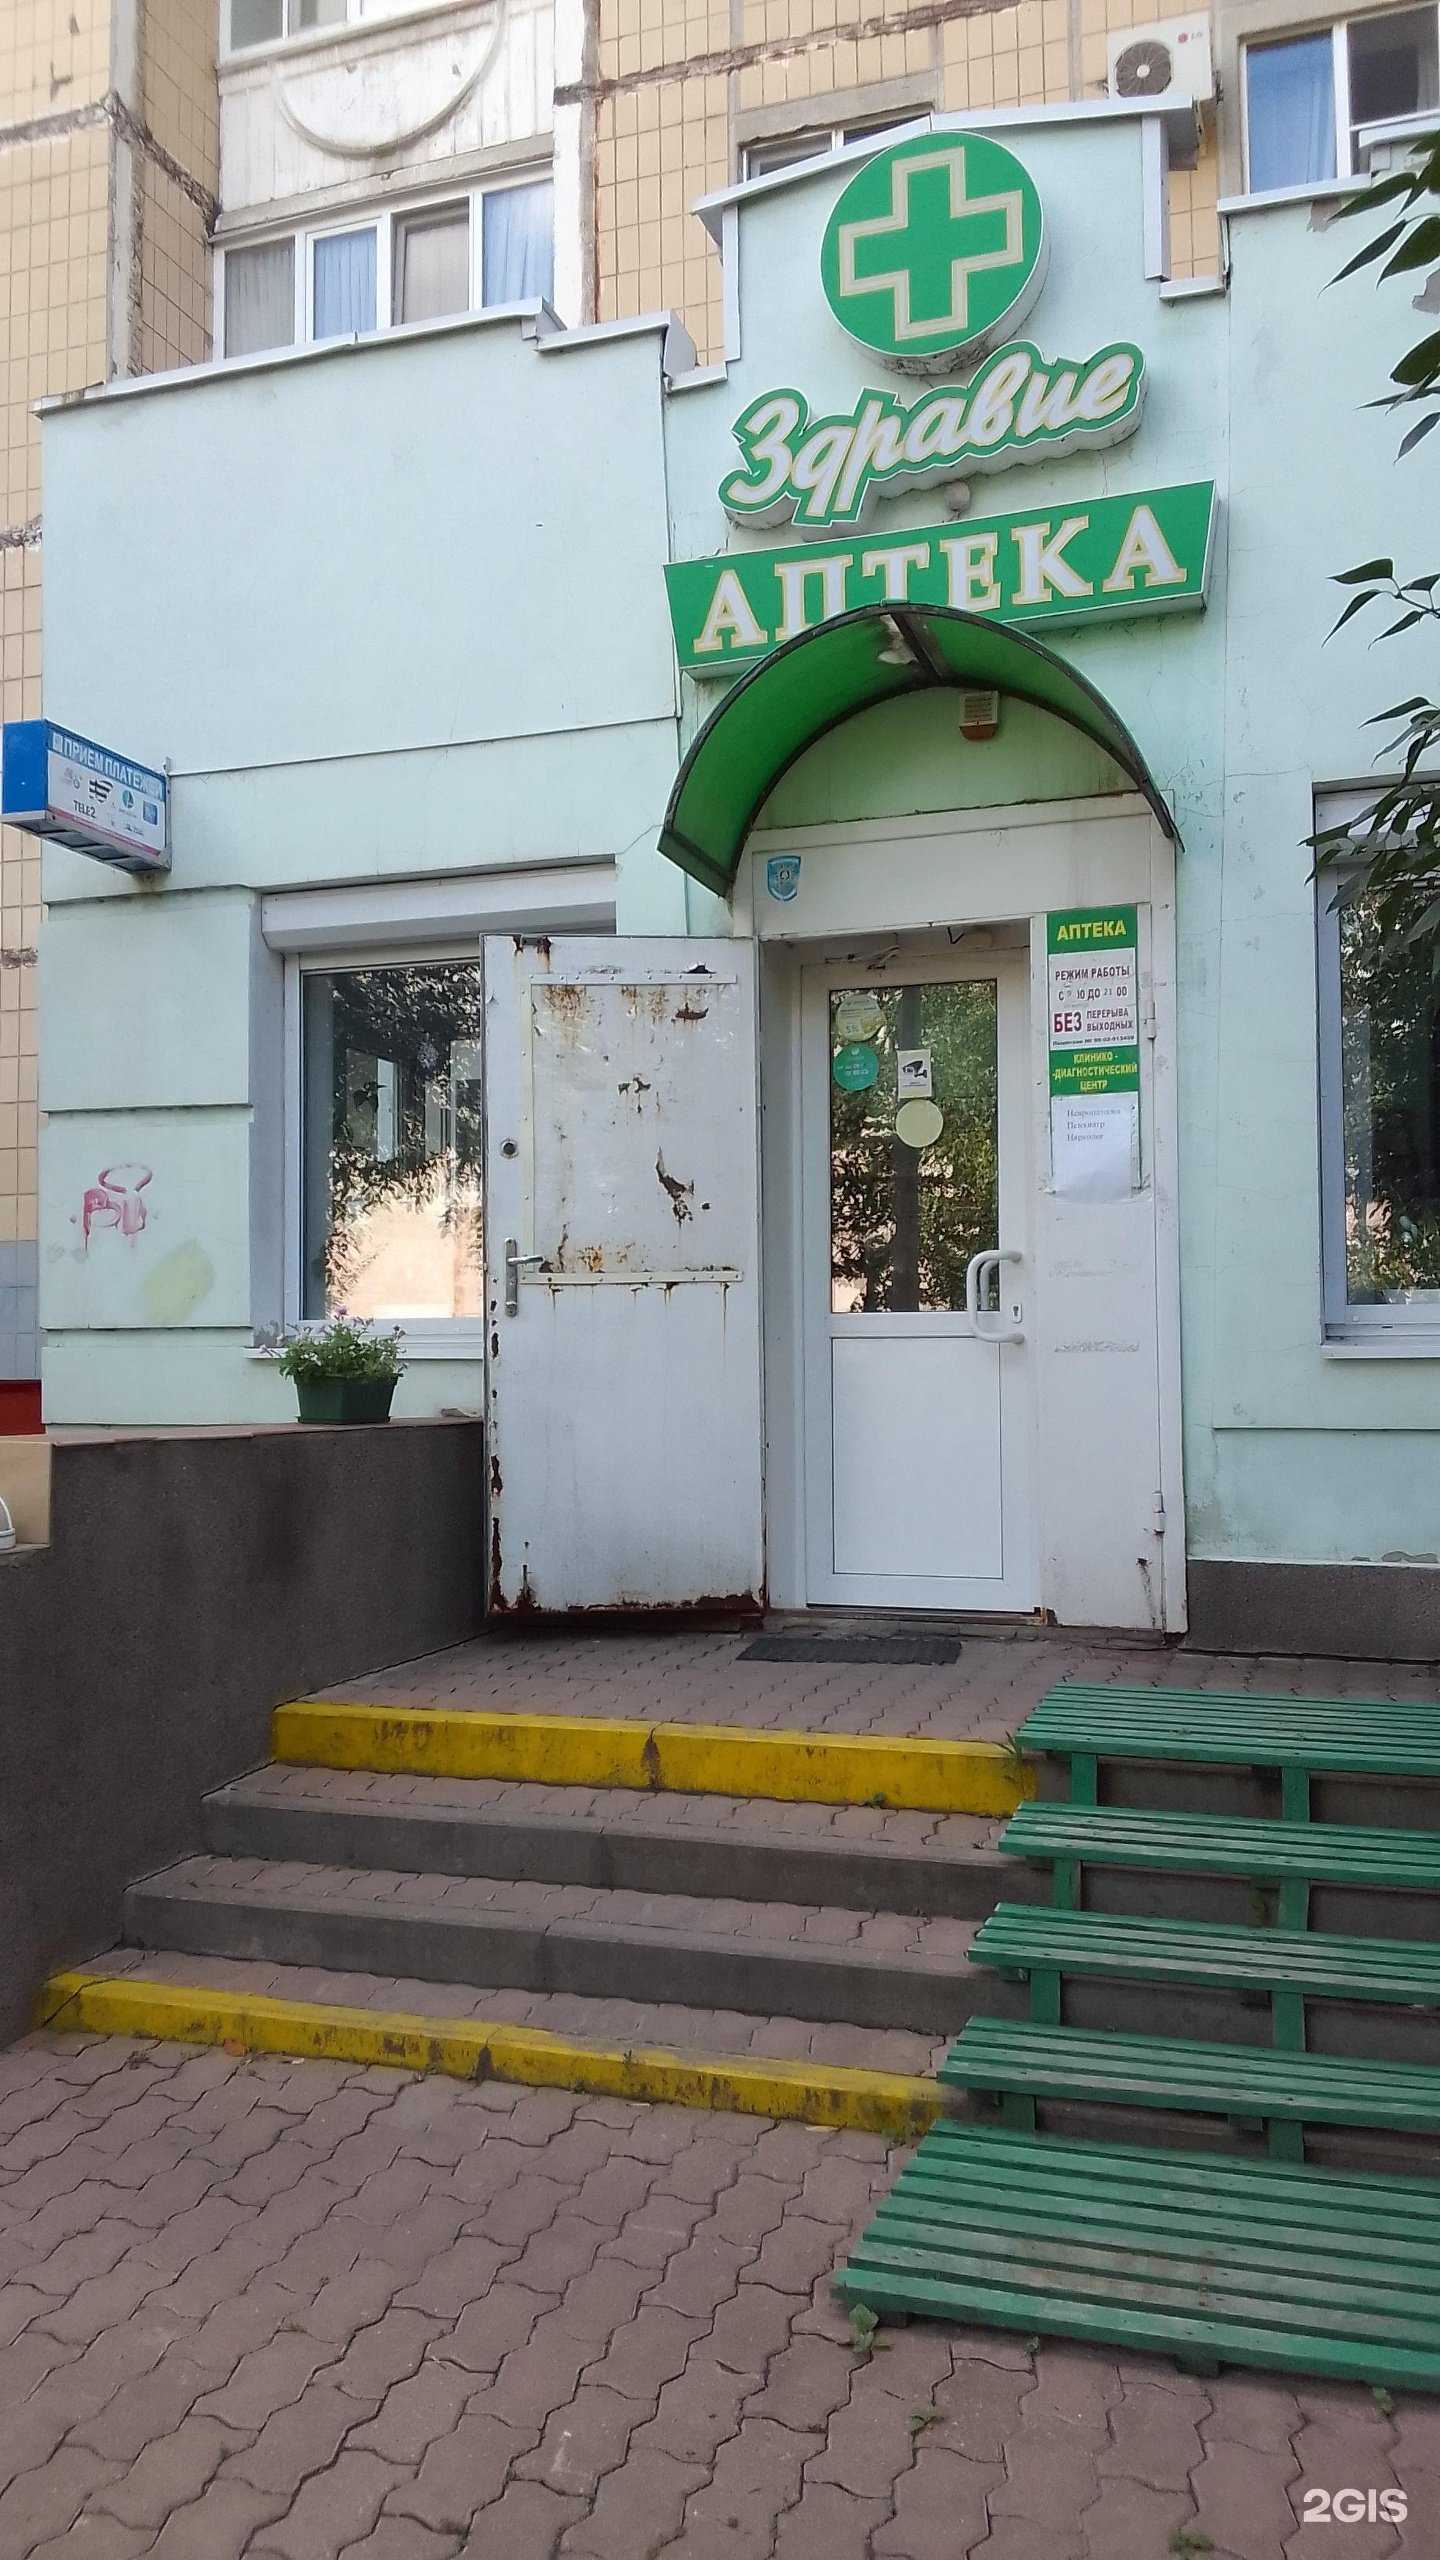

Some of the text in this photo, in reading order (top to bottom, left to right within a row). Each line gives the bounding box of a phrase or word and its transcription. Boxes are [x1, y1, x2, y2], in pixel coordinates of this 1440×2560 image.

[727, 350, 1136, 519] Здравие
[692, 504, 1188, 654] АПТЕКА
[73, 799, 96, 819] TELE2
[1056, 919, 1127, 941] АПТЕКА
[1055, 965, 1130, 981] РЕЖИМ РАБОТЫ
[1087, 987, 1101, 1001] ДО
[1053, 1011, 1083, 1033] БЕЗ
[1086, 1007, 1129, 1020] ПЕРЕРЫВА
[1086, 1020, 1134, 1032] ВЫХОДНЫХ
[1080, 1080, 1108, 1093] ЦЕНТР
